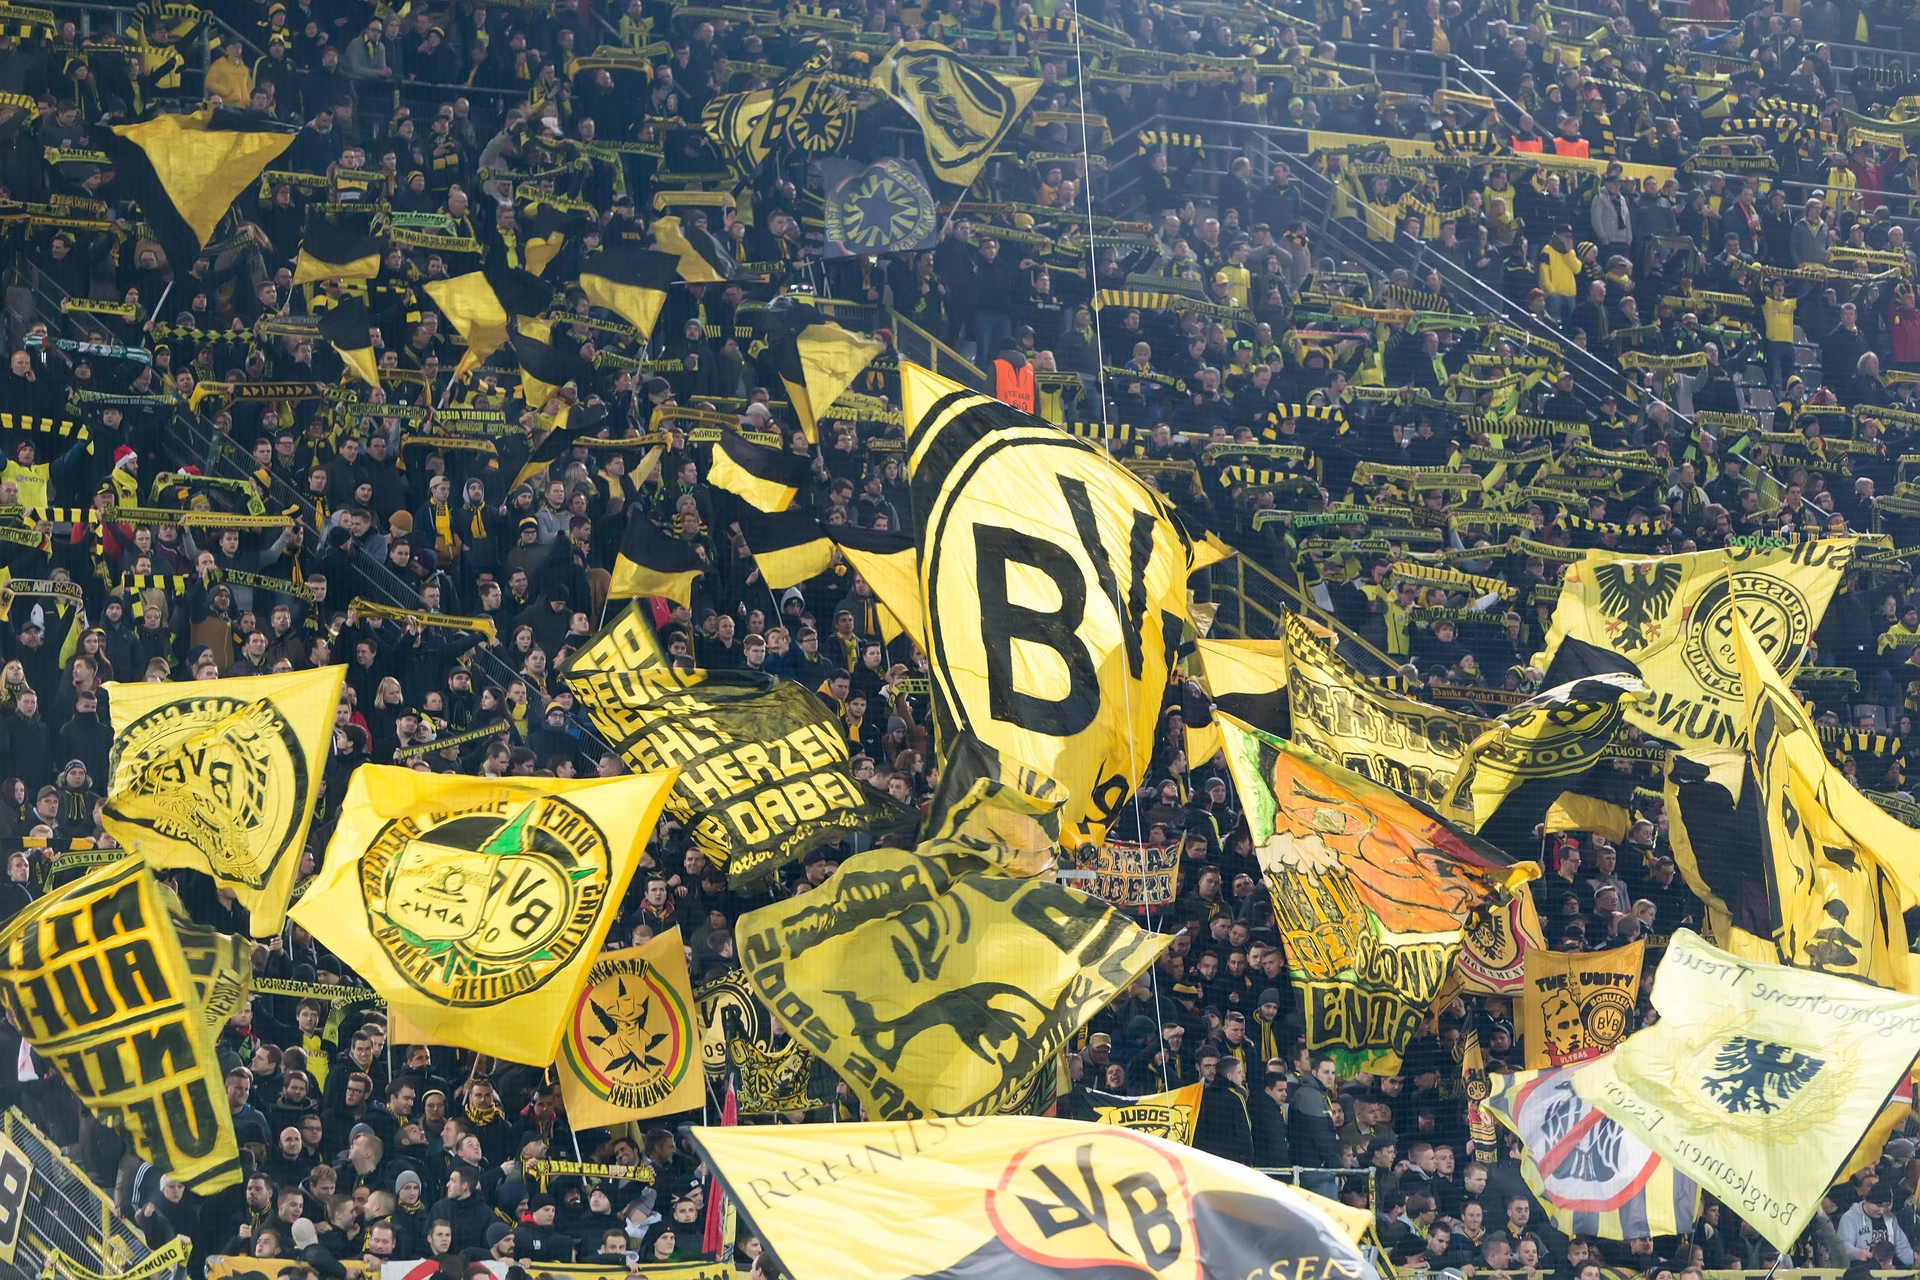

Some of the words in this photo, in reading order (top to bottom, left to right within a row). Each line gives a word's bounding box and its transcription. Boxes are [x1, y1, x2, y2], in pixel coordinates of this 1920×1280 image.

[1175, 298, 1215, 313] BORUSSIA
[350, 404, 384, 415] BORUSSIA
[388, 405, 426, 417] DORTMUND
[4, 506, 24, 514] alon
[122, 510, 169, 520] BORUSSIA
[32, 580, 53, 593] ANTI
[227, 570, 254, 583] BVB
[260, 576, 316, 600] DORTMUND
[1432, 687, 1461, 699] Danke
[680, 720, 850, 809] HERZEN
[725, 772, 865, 845] DABEI
[1096, 842, 1180, 874] LTRAS
[259, 977, 310, 994] BORUSSIA
[1535, 973, 1568, 993] THE
[1579, 972, 1635, 988] UNITY
[1597, 1010, 1620, 1032] BVB
[704, 1044, 725, 1059] 09
[1560, 1051, 1589, 1064] ULTRAS
[1468, 1081, 1486, 1096] BVB
[1118, 1109, 1170, 1124] JUBOS
